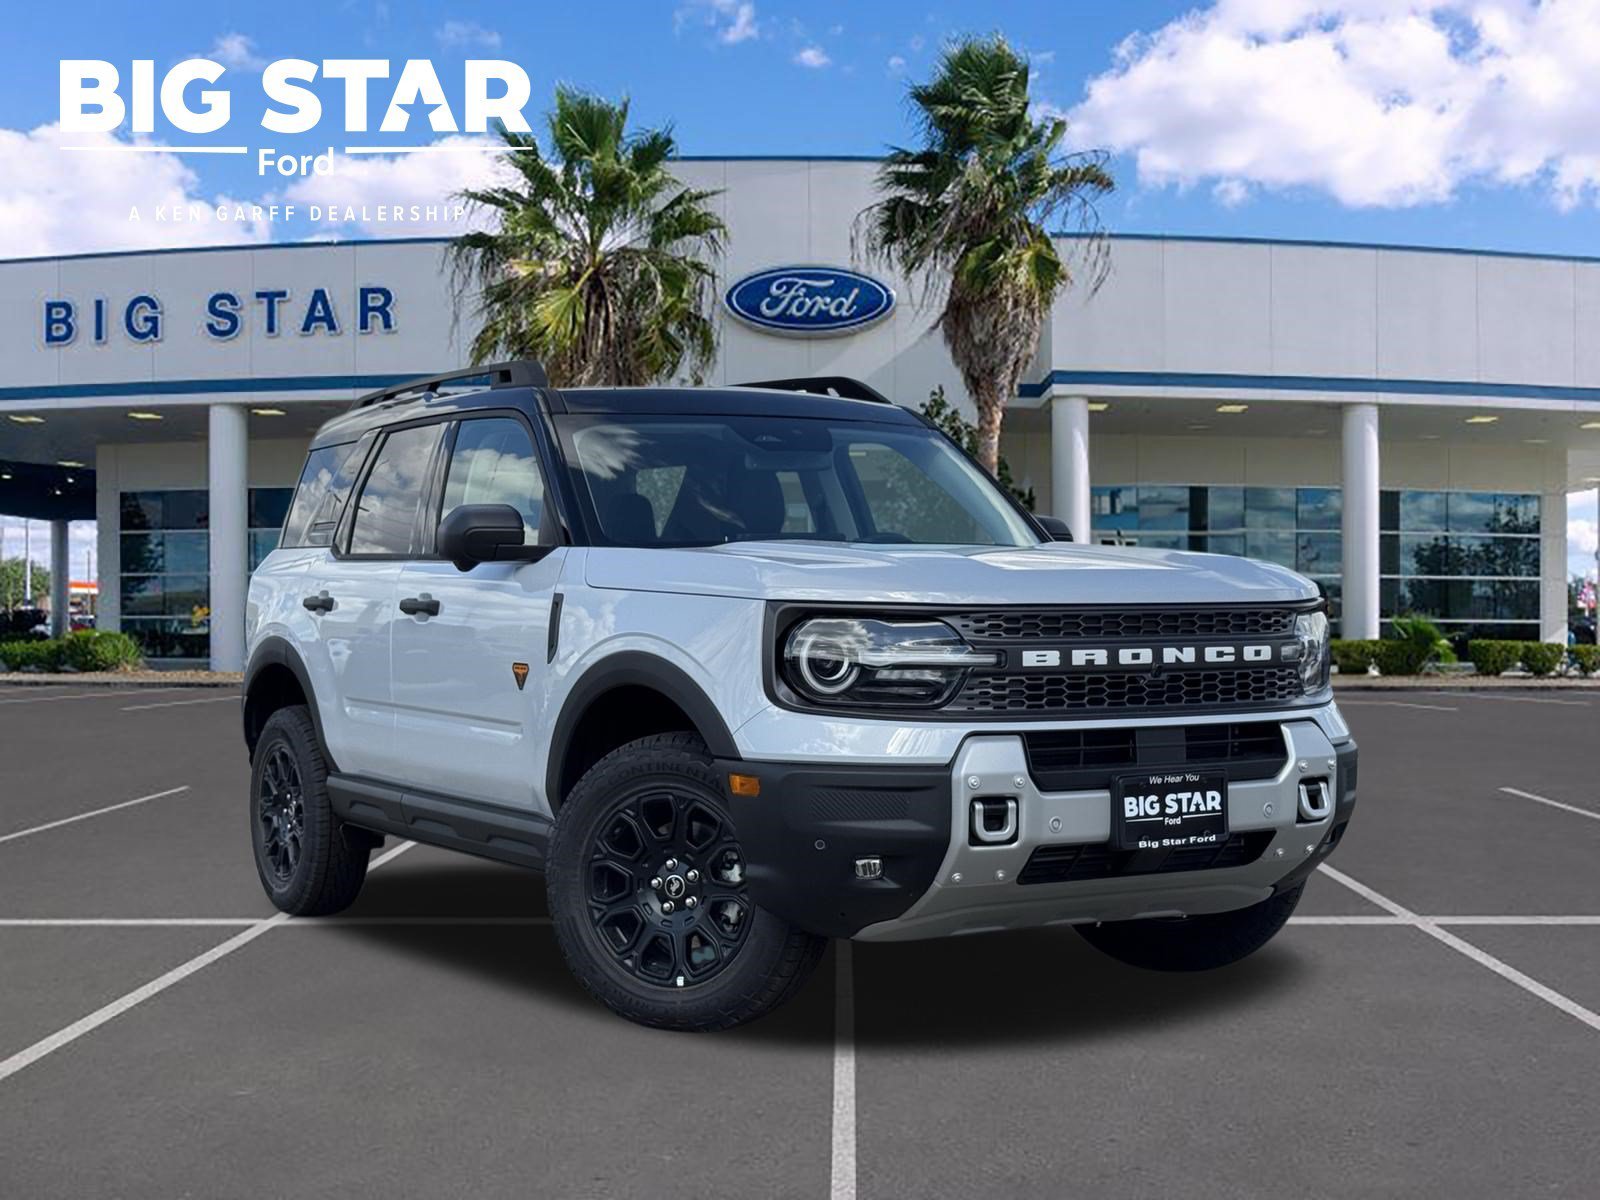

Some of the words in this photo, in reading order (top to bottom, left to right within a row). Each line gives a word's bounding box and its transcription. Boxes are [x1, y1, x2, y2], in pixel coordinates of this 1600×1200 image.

[760, 277, 859, 317] Ford
[45, 295, 164, 344] BIG
[206, 287, 397, 339] STAR
[1022, 645, 1272, 667] BRONCO
[1149, 776, 1162, 785] We
[1164, 775, 1183, 784] Hear
[1185, 773, 1200, 782] You
[1124, 795, 1160, 818] BIG
[1165, 790, 1222, 815] STAR
[1164, 816, 1182, 826] Ford
[1138, 840, 1159, 849] Big
[1162, 837, 1187, 846] Star
[1189, 834, 1216, 844] Ford
